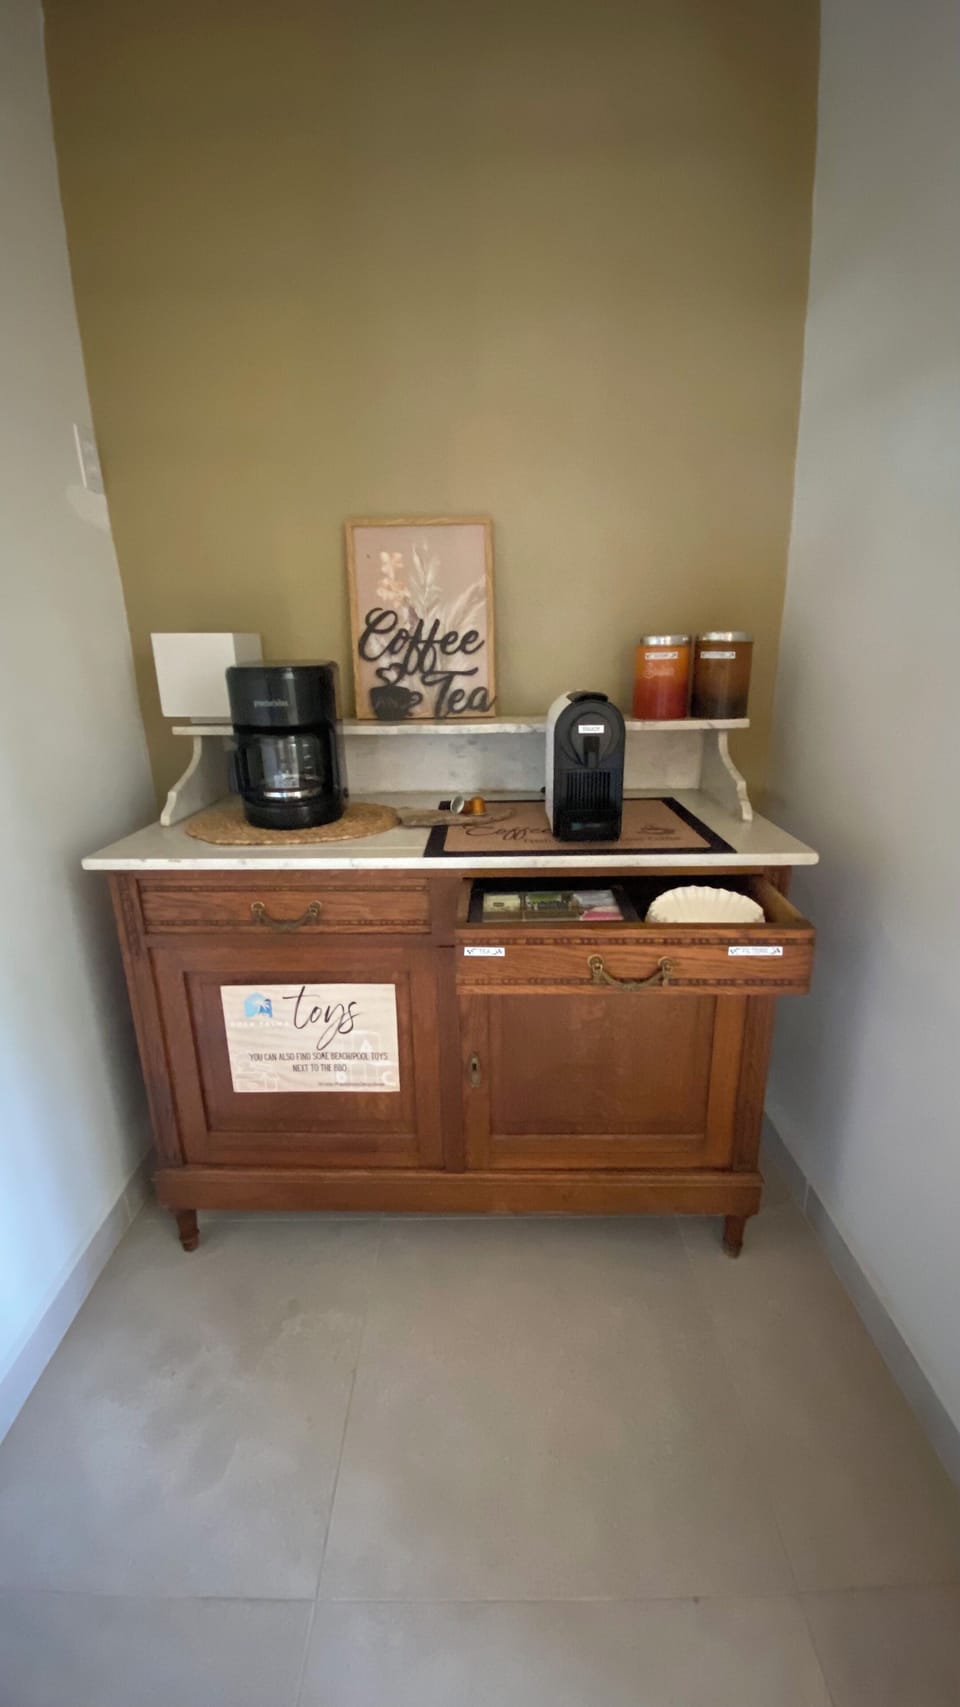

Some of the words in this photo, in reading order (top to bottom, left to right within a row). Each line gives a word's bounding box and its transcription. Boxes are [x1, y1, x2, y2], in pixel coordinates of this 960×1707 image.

[358, 608, 485, 675] Coffee
[421, 667, 498, 720] Tea
[282, 986, 362, 1050] toys
[249, 1052, 263, 1061] YOU
[264, 1052, 278, 1061] CAN
[279, 1052, 295, 1060] ALSO
[296, 1052, 311, 1060] FIND
[312, 1052, 329, 1060] SOME
[371, 1052, 388, 1061] TOYS
[293, 1064, 308, 1072] NEXT
[311, 1064, 319, 1072] TO
[320, 1064, 331, 1072] THE
